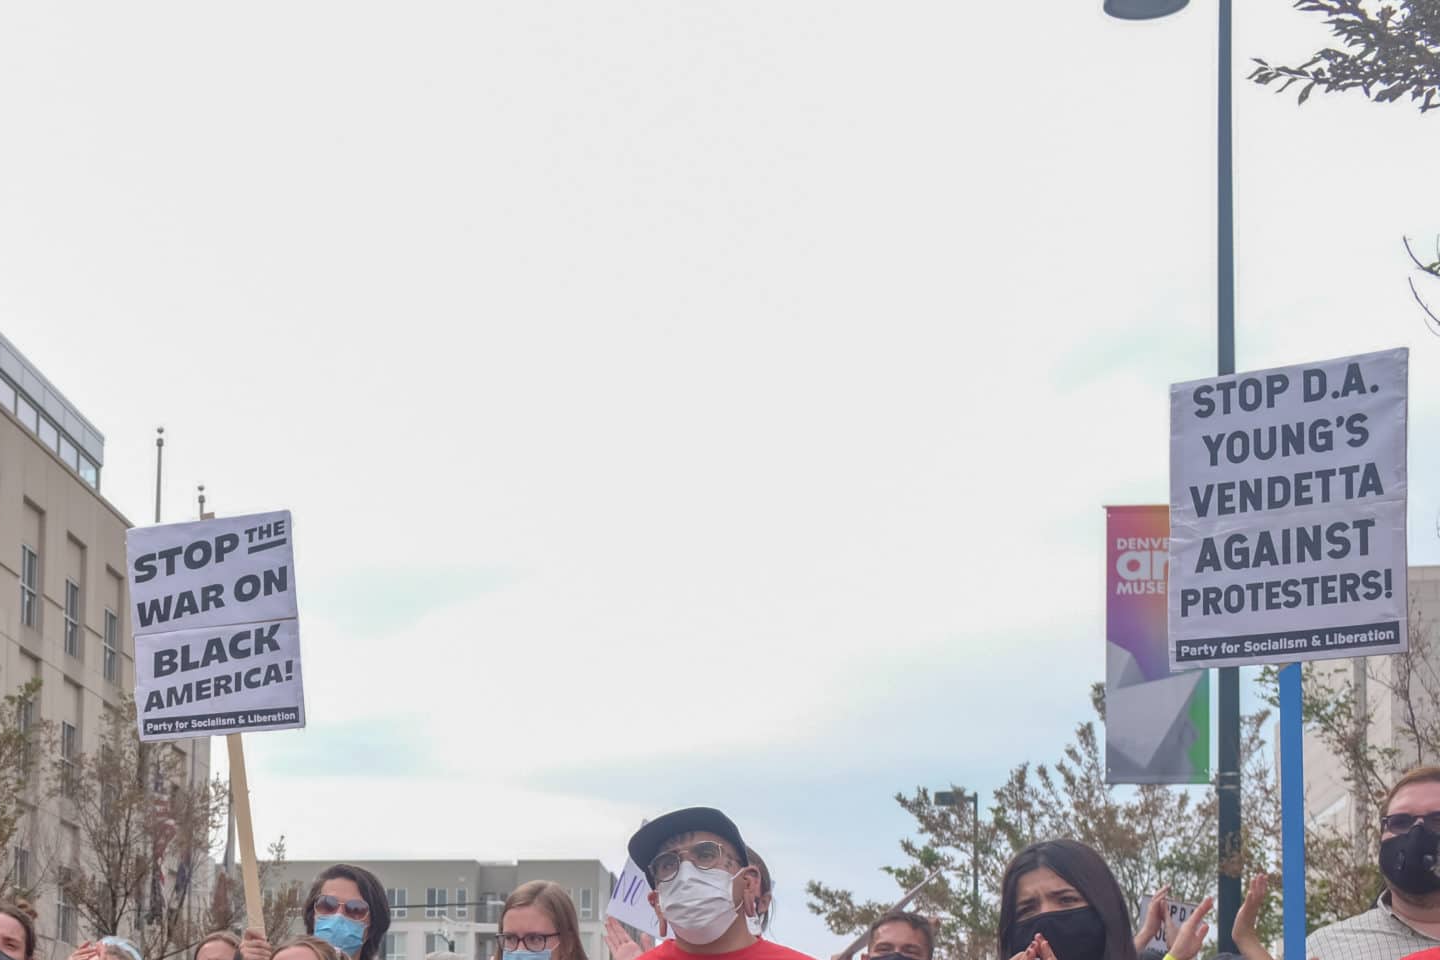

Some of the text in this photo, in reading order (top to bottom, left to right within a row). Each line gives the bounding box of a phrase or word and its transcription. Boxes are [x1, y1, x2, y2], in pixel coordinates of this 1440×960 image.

[1193, 362, 1379, 418] STOP D.A.
[1202, 412, 1370, 466] YOUNG'S
[1189, 462, 1384, 518] VENDETTA
[134, 520, 285, 584] STOP THE
[1116, 537, 1170, 551] DENVE
[1195, 519, 1375, 573] AGAINST
[137, 566, 288, 628] WAR ON
[1116, 582, 1166, 595] MUSE
[1180, 568, 1394, 618] PROTESTERS!
[154, 623, 281, 679] BLACK
[1181, 629, 1395, 657] Party for Socialism & Liberation
[144, 660, 293, 713] AMERICA!
[147, 711, 296, 733] Party for Socialism & Liberation
